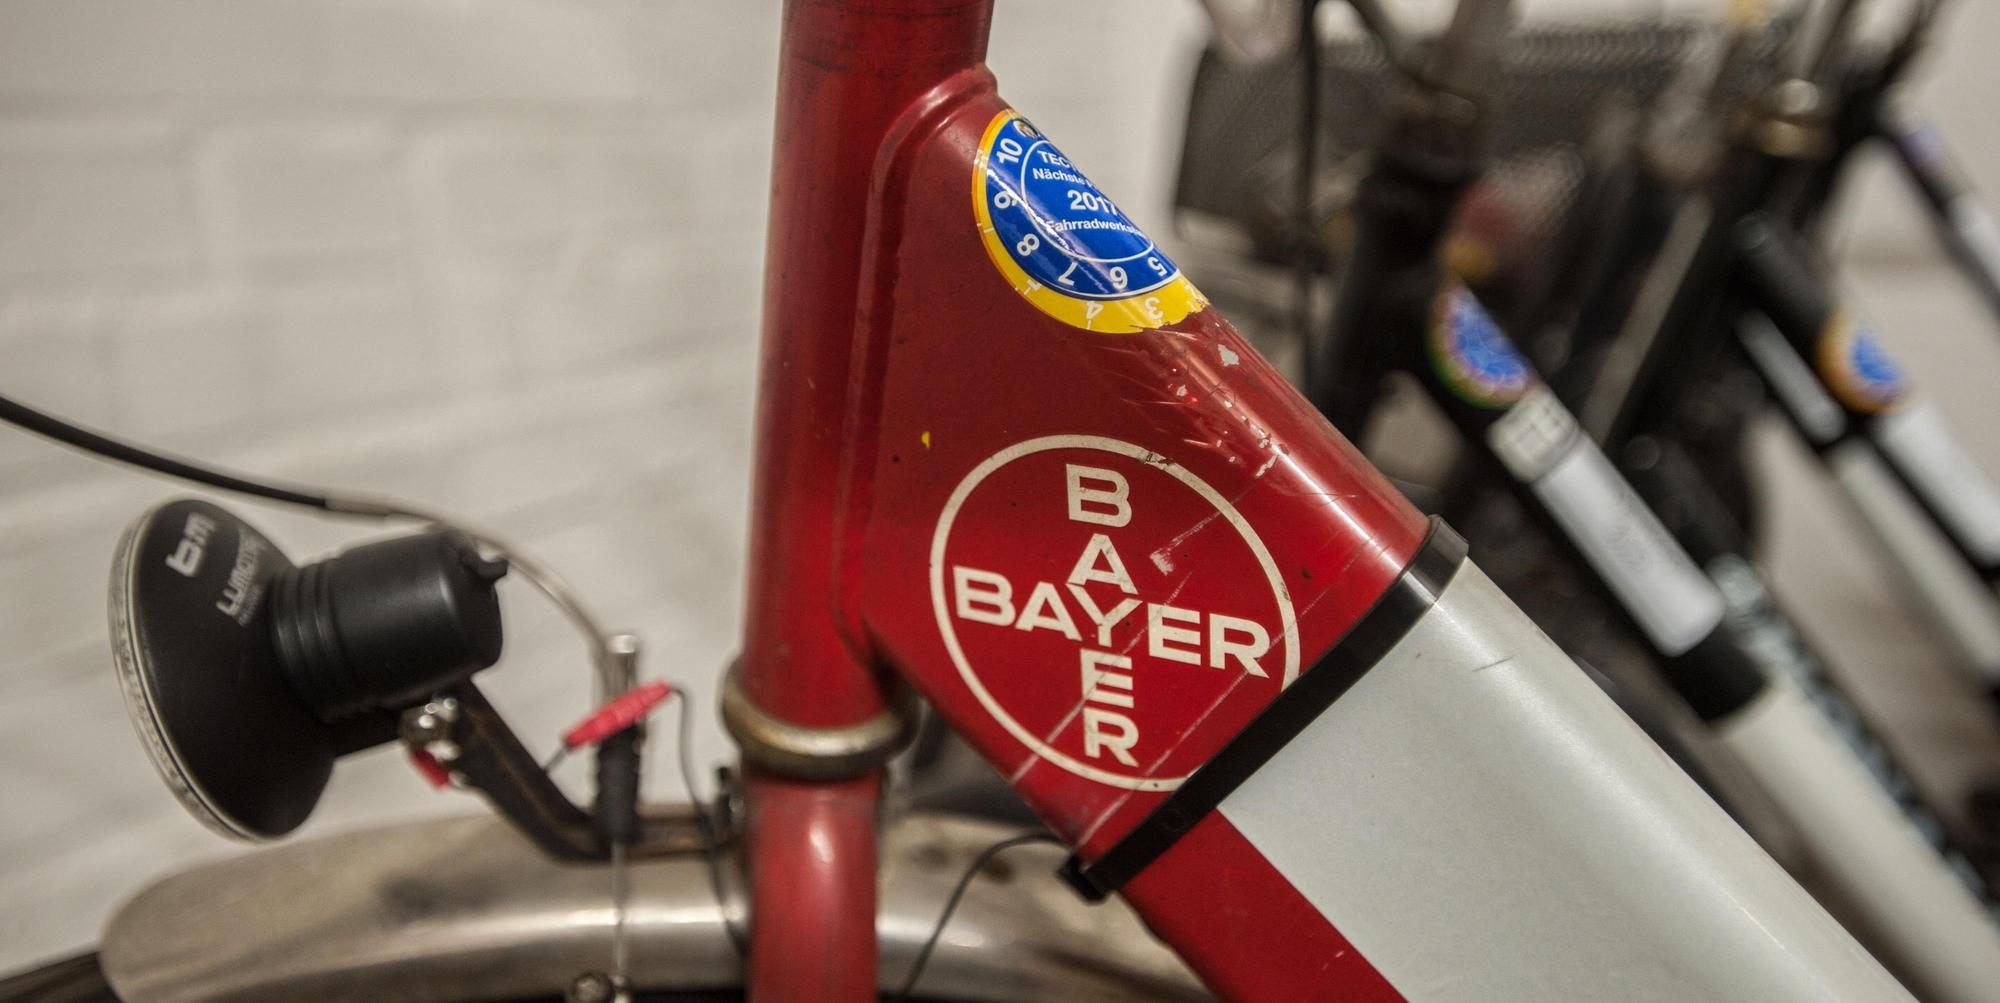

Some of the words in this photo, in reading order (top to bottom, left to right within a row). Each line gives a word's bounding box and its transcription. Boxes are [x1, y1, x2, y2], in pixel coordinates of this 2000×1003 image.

[996, 138, 1023, 163] 10
[1037, 150, 1075, 172] TEC
[1067, 189, 1117, 216] 2017
[1016, 233, 1040, 257] 8
[1058, 261, 1079, 287] 7
[1109, 266, 1128, 289] 6
[1147, 256, 1168, 277] 5
[1086, 301, 1105, 319] 4
[1144, 297, 1164, 320] 3
[953, 565, 1271, 678] BAYER
[1066, 463, 1143, 767] BAYER
